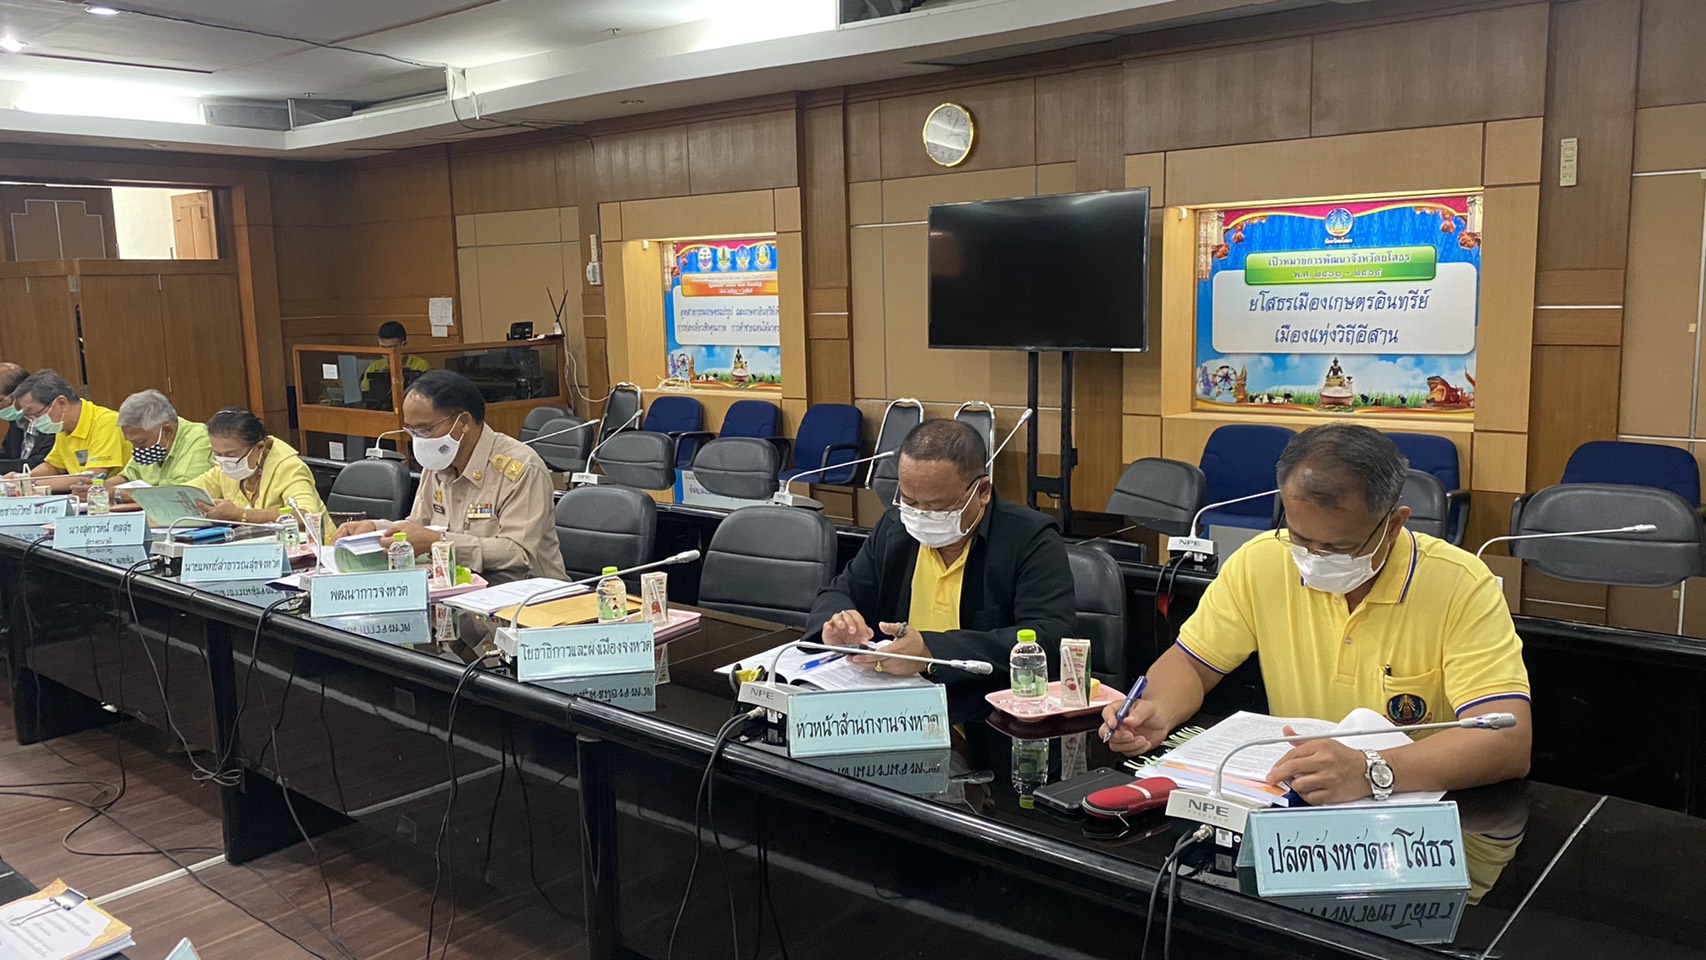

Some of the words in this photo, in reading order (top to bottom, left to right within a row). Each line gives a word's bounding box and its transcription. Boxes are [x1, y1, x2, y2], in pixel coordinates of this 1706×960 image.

[1249, 288, 1432, 312] ยโสธรเมืองเกษตรอินทรีย์
[1274, 323, 1399, 345] เมืองแห่งวิถีอีสาน
[1179, 539, 1201, 547] NPE
[330, 580, 409, 601] พัฒนาการจังหวัด
[750, 687, 775, 701] NPE
[1188, 799, 1230, 818] NPE
